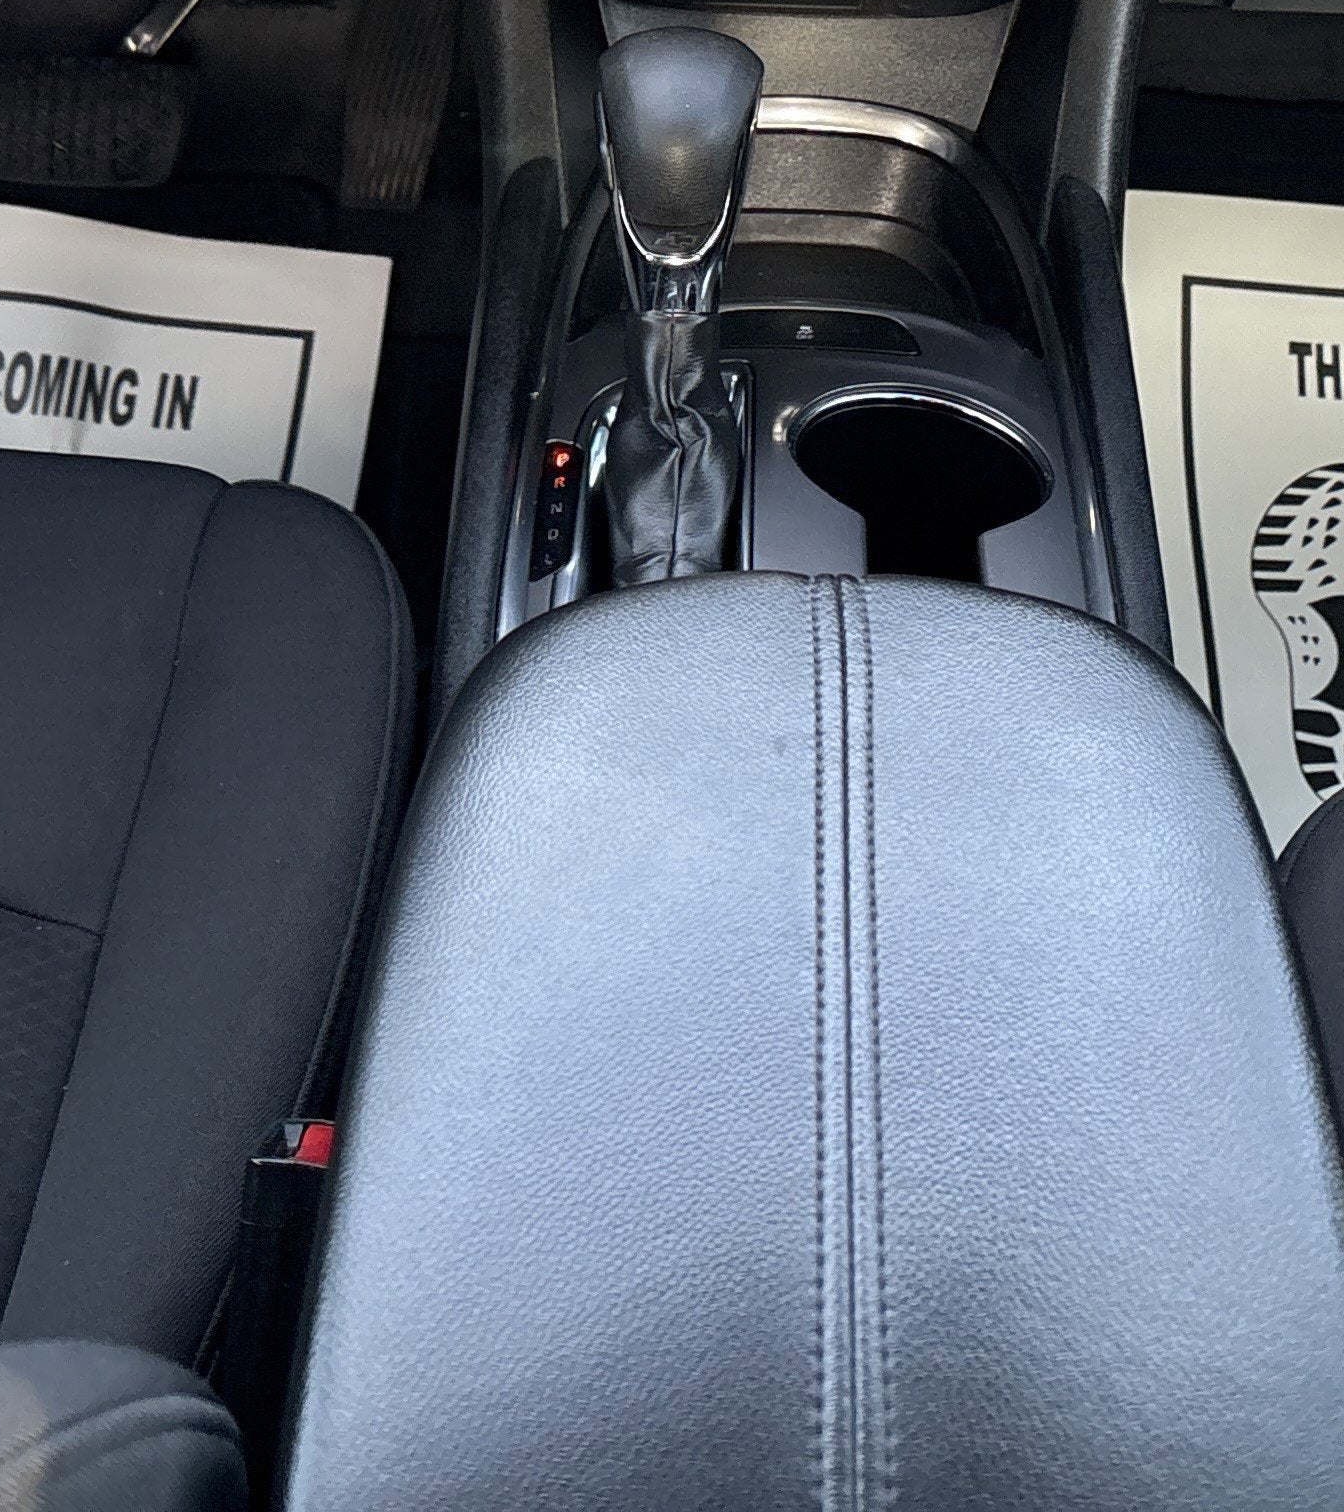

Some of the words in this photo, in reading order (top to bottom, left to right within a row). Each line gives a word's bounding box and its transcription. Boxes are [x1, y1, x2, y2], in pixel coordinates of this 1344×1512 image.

[151, 371, 201, 434] IN
[556, 452, 570, 467] P
[554, 476, 565, 488] R
[550, 501, 563, 515] N
